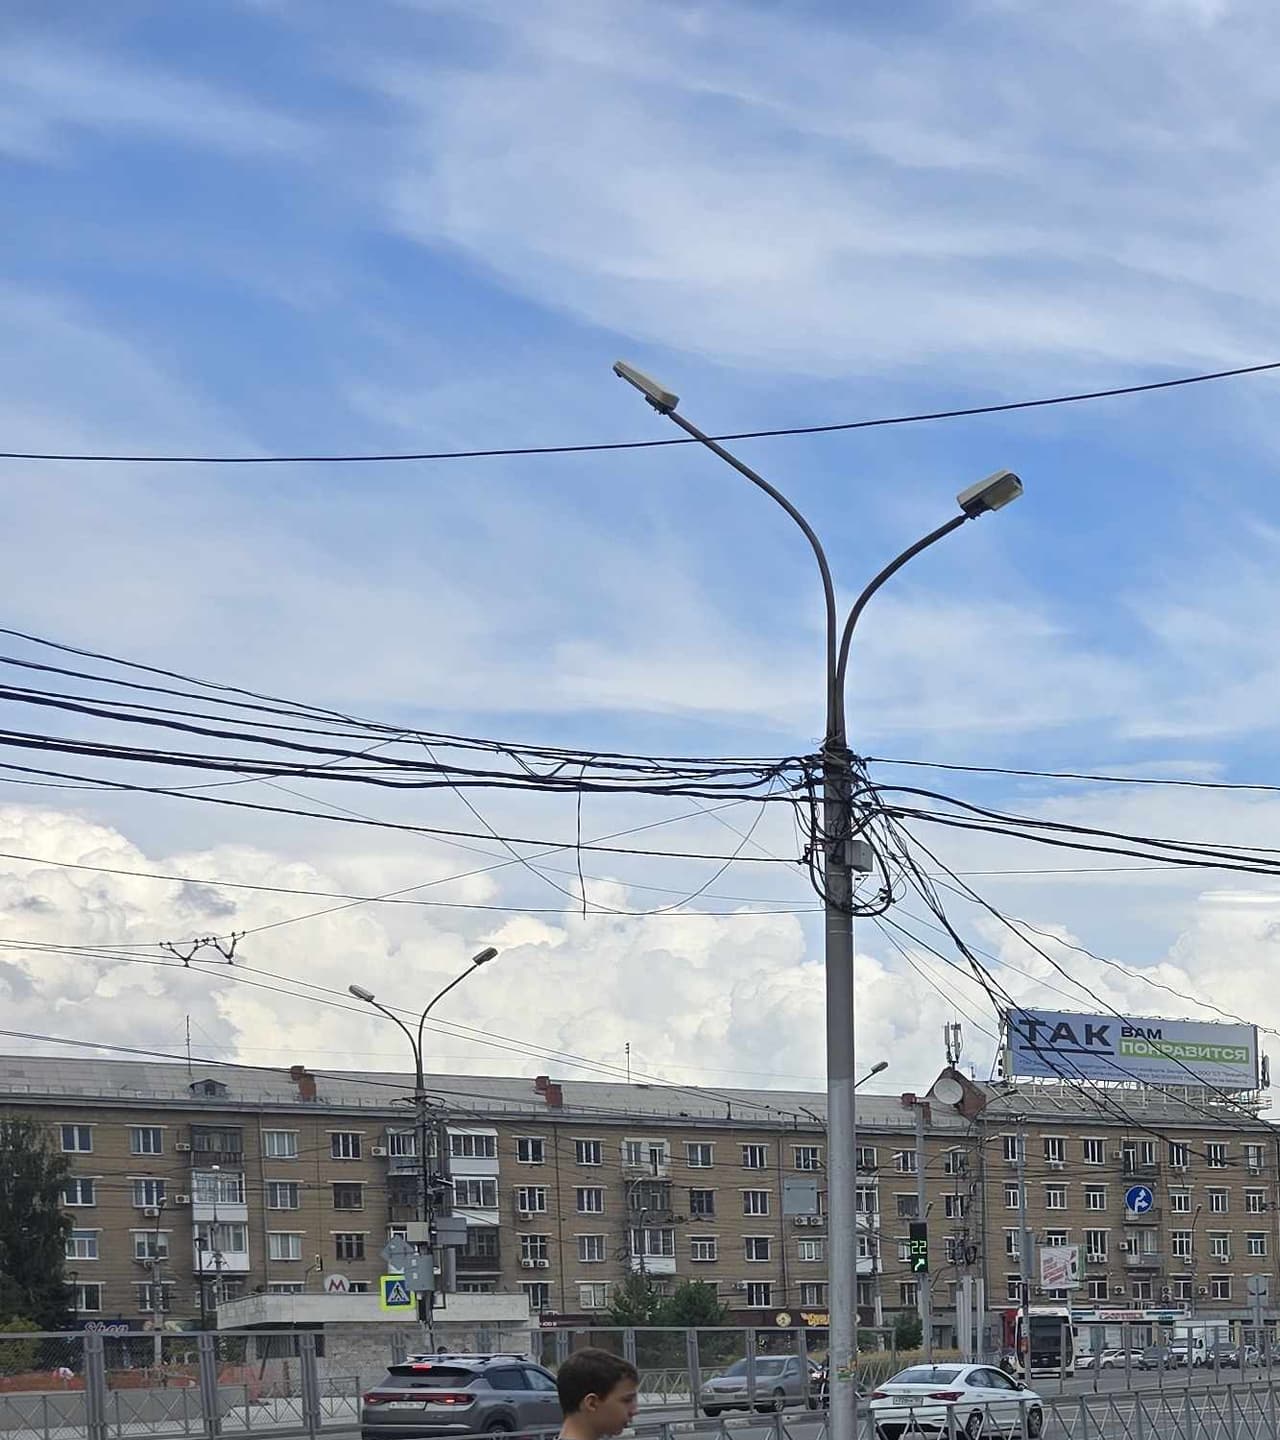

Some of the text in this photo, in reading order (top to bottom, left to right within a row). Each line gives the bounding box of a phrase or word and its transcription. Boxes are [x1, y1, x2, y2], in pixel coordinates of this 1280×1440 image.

[1019, 1019, 1162, 1047] ТАК ВАМ
[1121, 1041, 1247, 1061] ПОНРАВИТСЯ
[911, 1240, 927, 1254] 22
[328, 1279, 346, 1292] М
